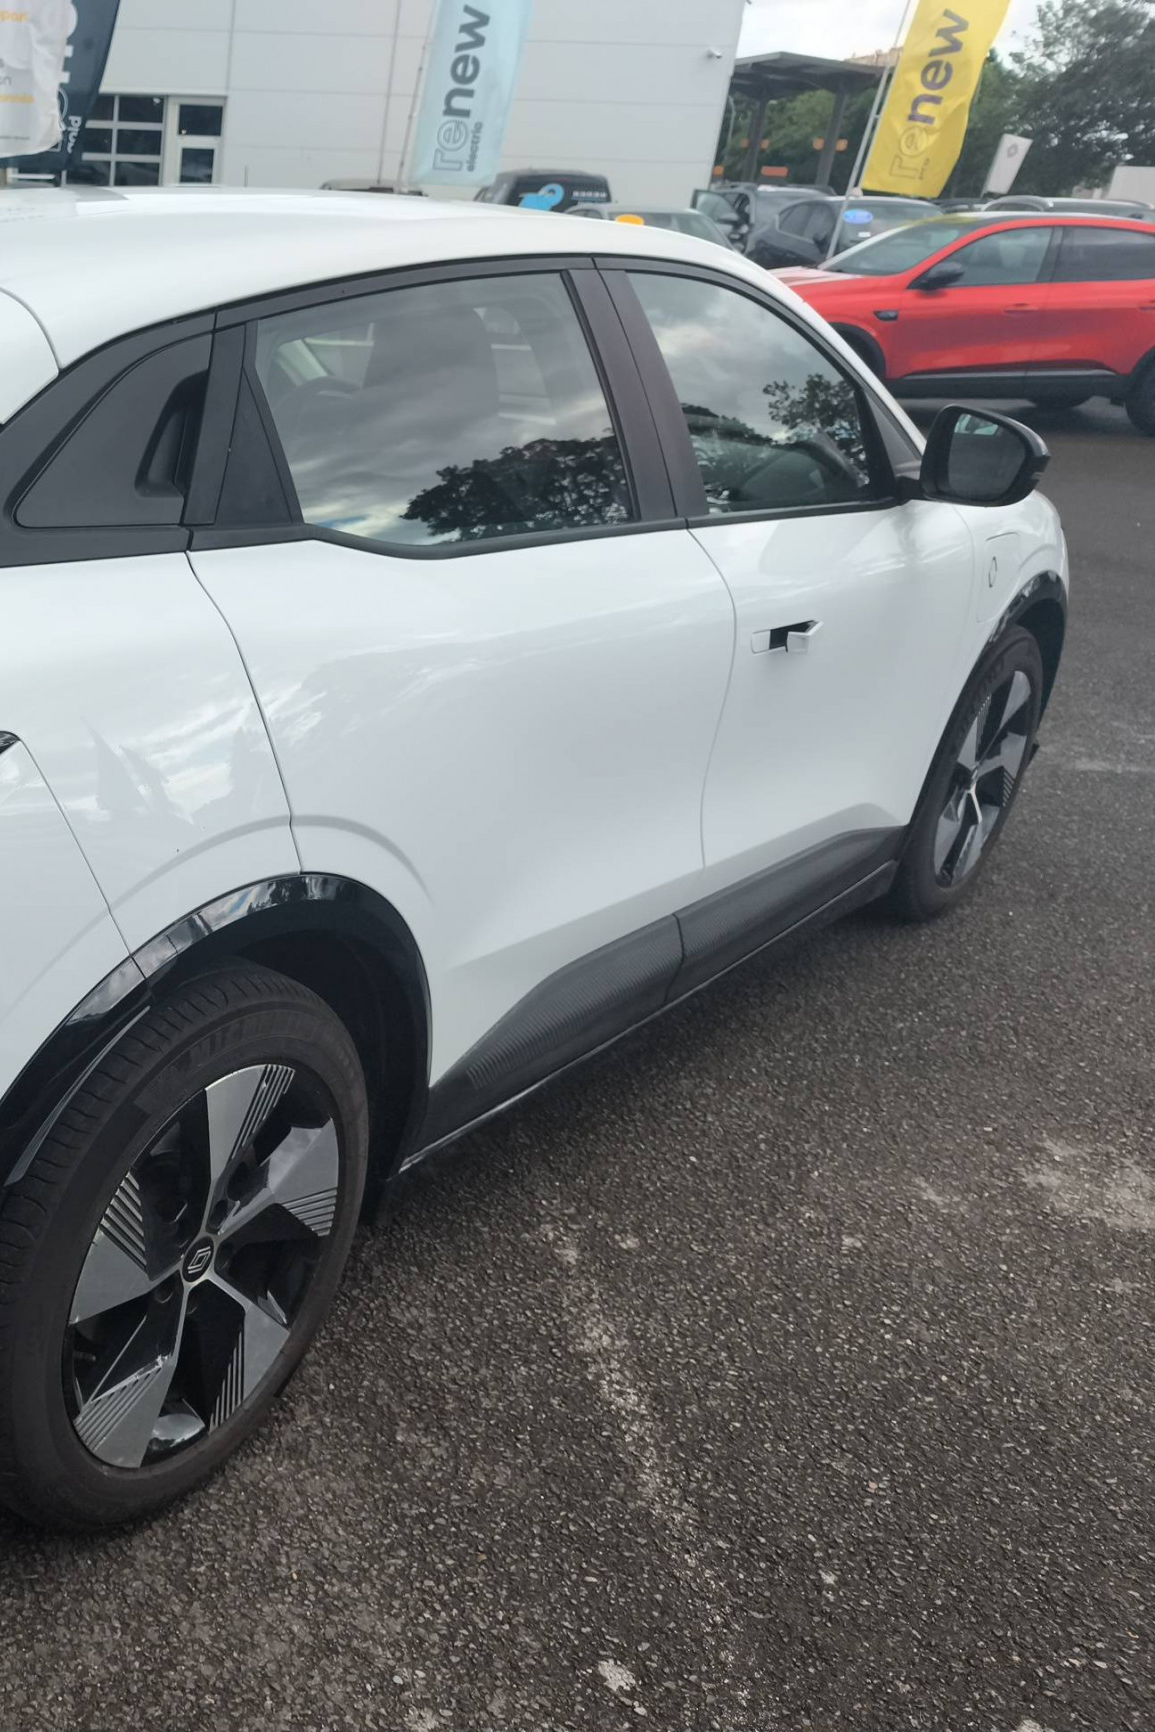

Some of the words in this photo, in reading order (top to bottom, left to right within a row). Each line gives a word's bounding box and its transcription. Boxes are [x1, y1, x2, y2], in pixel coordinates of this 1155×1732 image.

[432, 4, 491, 172] renew
[465, 121, 484, 172] electric
[889, 8, 969, 180] renew
